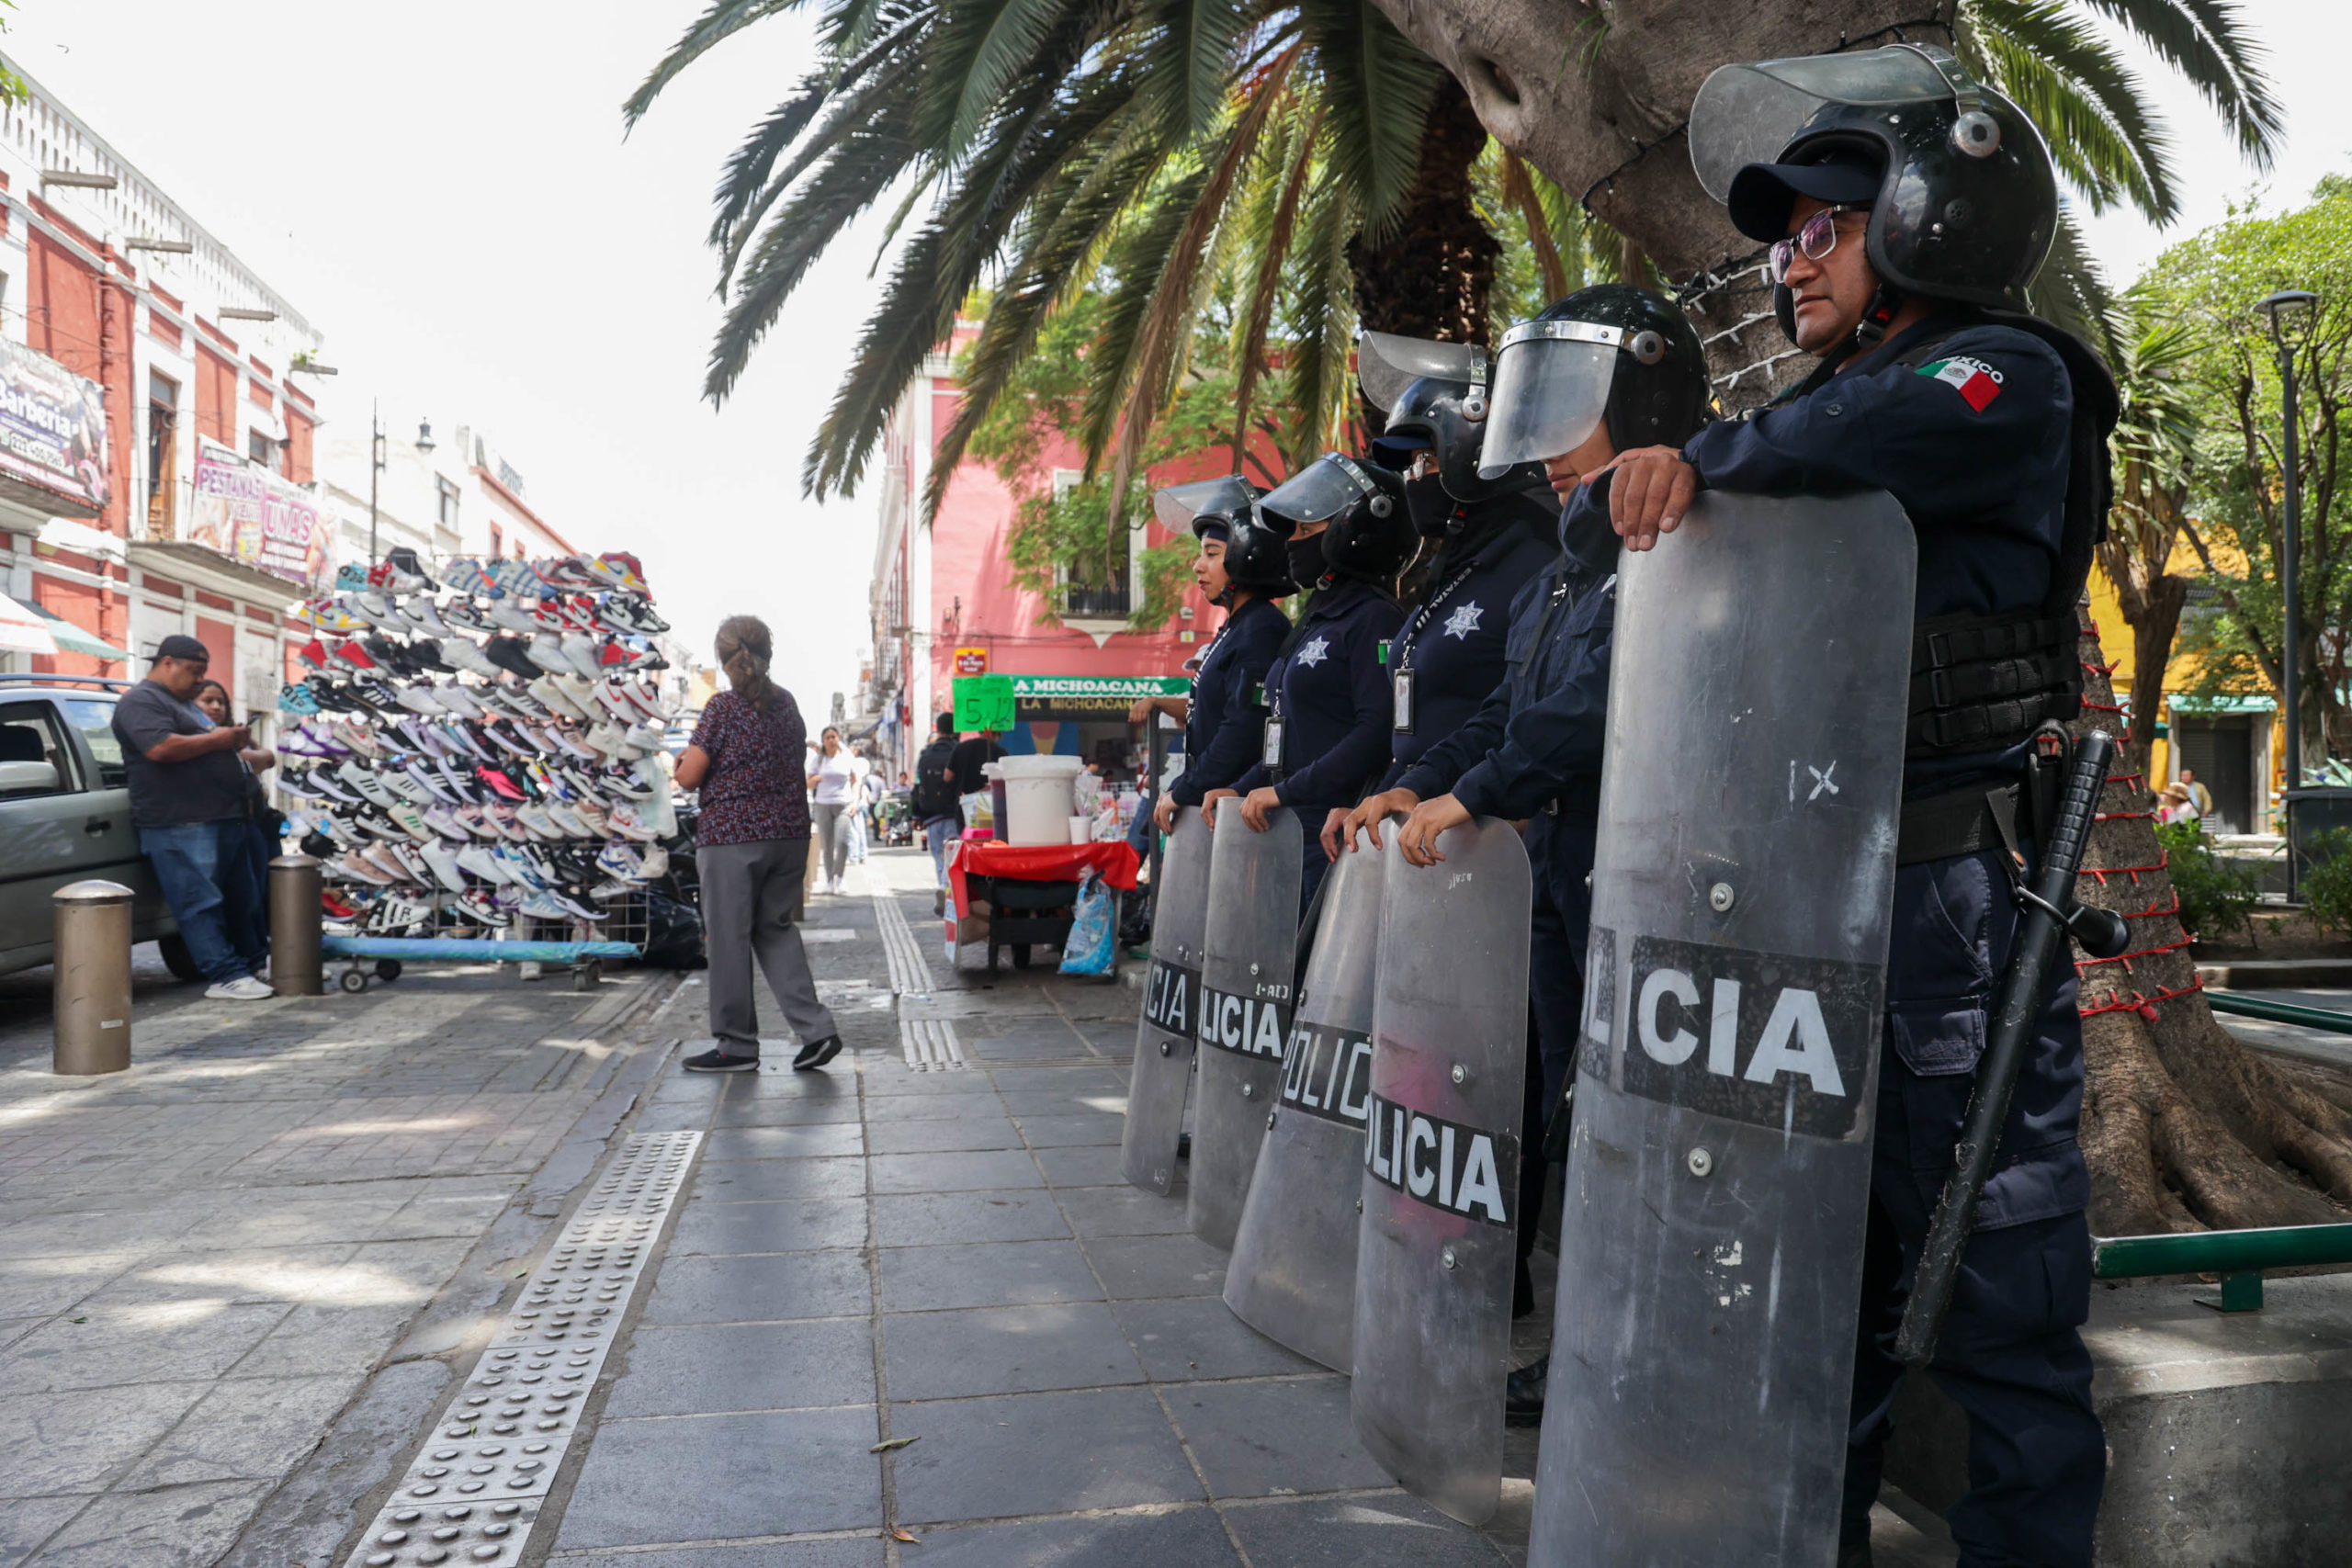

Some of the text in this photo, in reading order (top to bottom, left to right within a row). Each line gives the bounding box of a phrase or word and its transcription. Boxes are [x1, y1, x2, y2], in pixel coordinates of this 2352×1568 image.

[1014, 680, 1030, 692] A
[1033, 680, 1164, 694] MICHOACANA
[966, 698, 982, 724] 5
[1022, 698, 1134, 710] LA MICHOACAN
[1198, 988, 1283, 1058] LICIA
[1580, 950, 1846, 1097] LICIA
